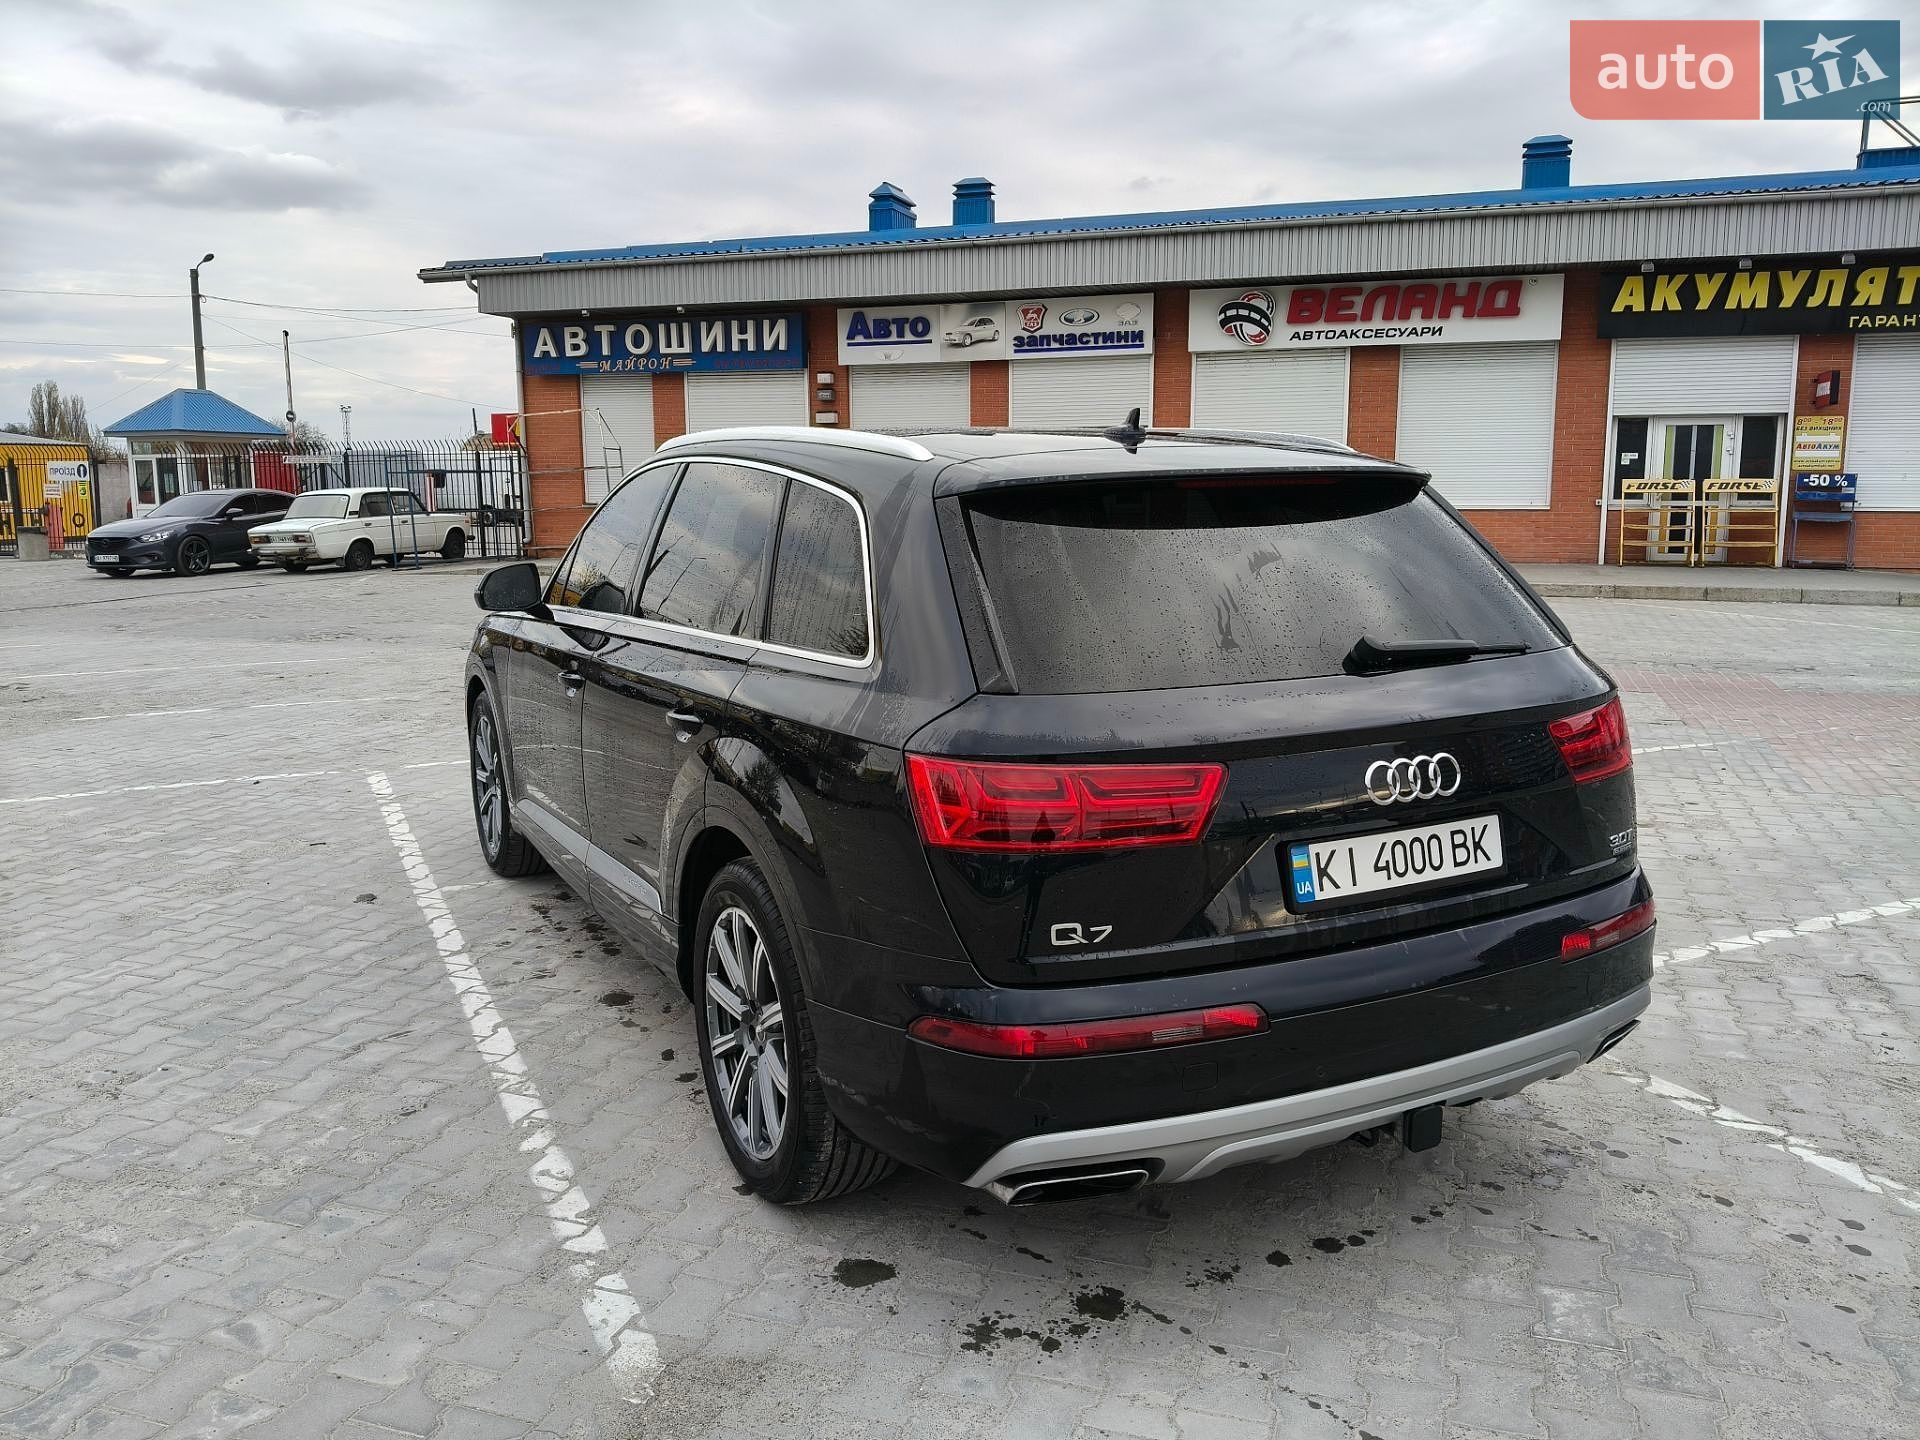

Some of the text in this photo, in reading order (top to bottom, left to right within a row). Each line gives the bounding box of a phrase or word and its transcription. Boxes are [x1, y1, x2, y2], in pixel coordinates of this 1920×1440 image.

[1610, 265, 1920, 313] АКУМУЛЯТ
[1286, 279, 1524, 325] ВЕЛАНД
[846, 310, 931, 341] Авто
[1289, 325, 1444, 342] АВТОАКСЕСУАРИ
[1849, 314, 1920, 328] ГАРАН
[533, 318, 789, 358] АВТОШИНИ
[1013, 329, 1144, 348] запчастини
[600, 355, 671, 373] МАЙРОН
[49, 466, 76, 477] ПРОЇЗД
[1296, 881, 1313, 895] UA
[1373, 833, 1444, 881] 4000
[1450, 823, 1492, 868] BK
